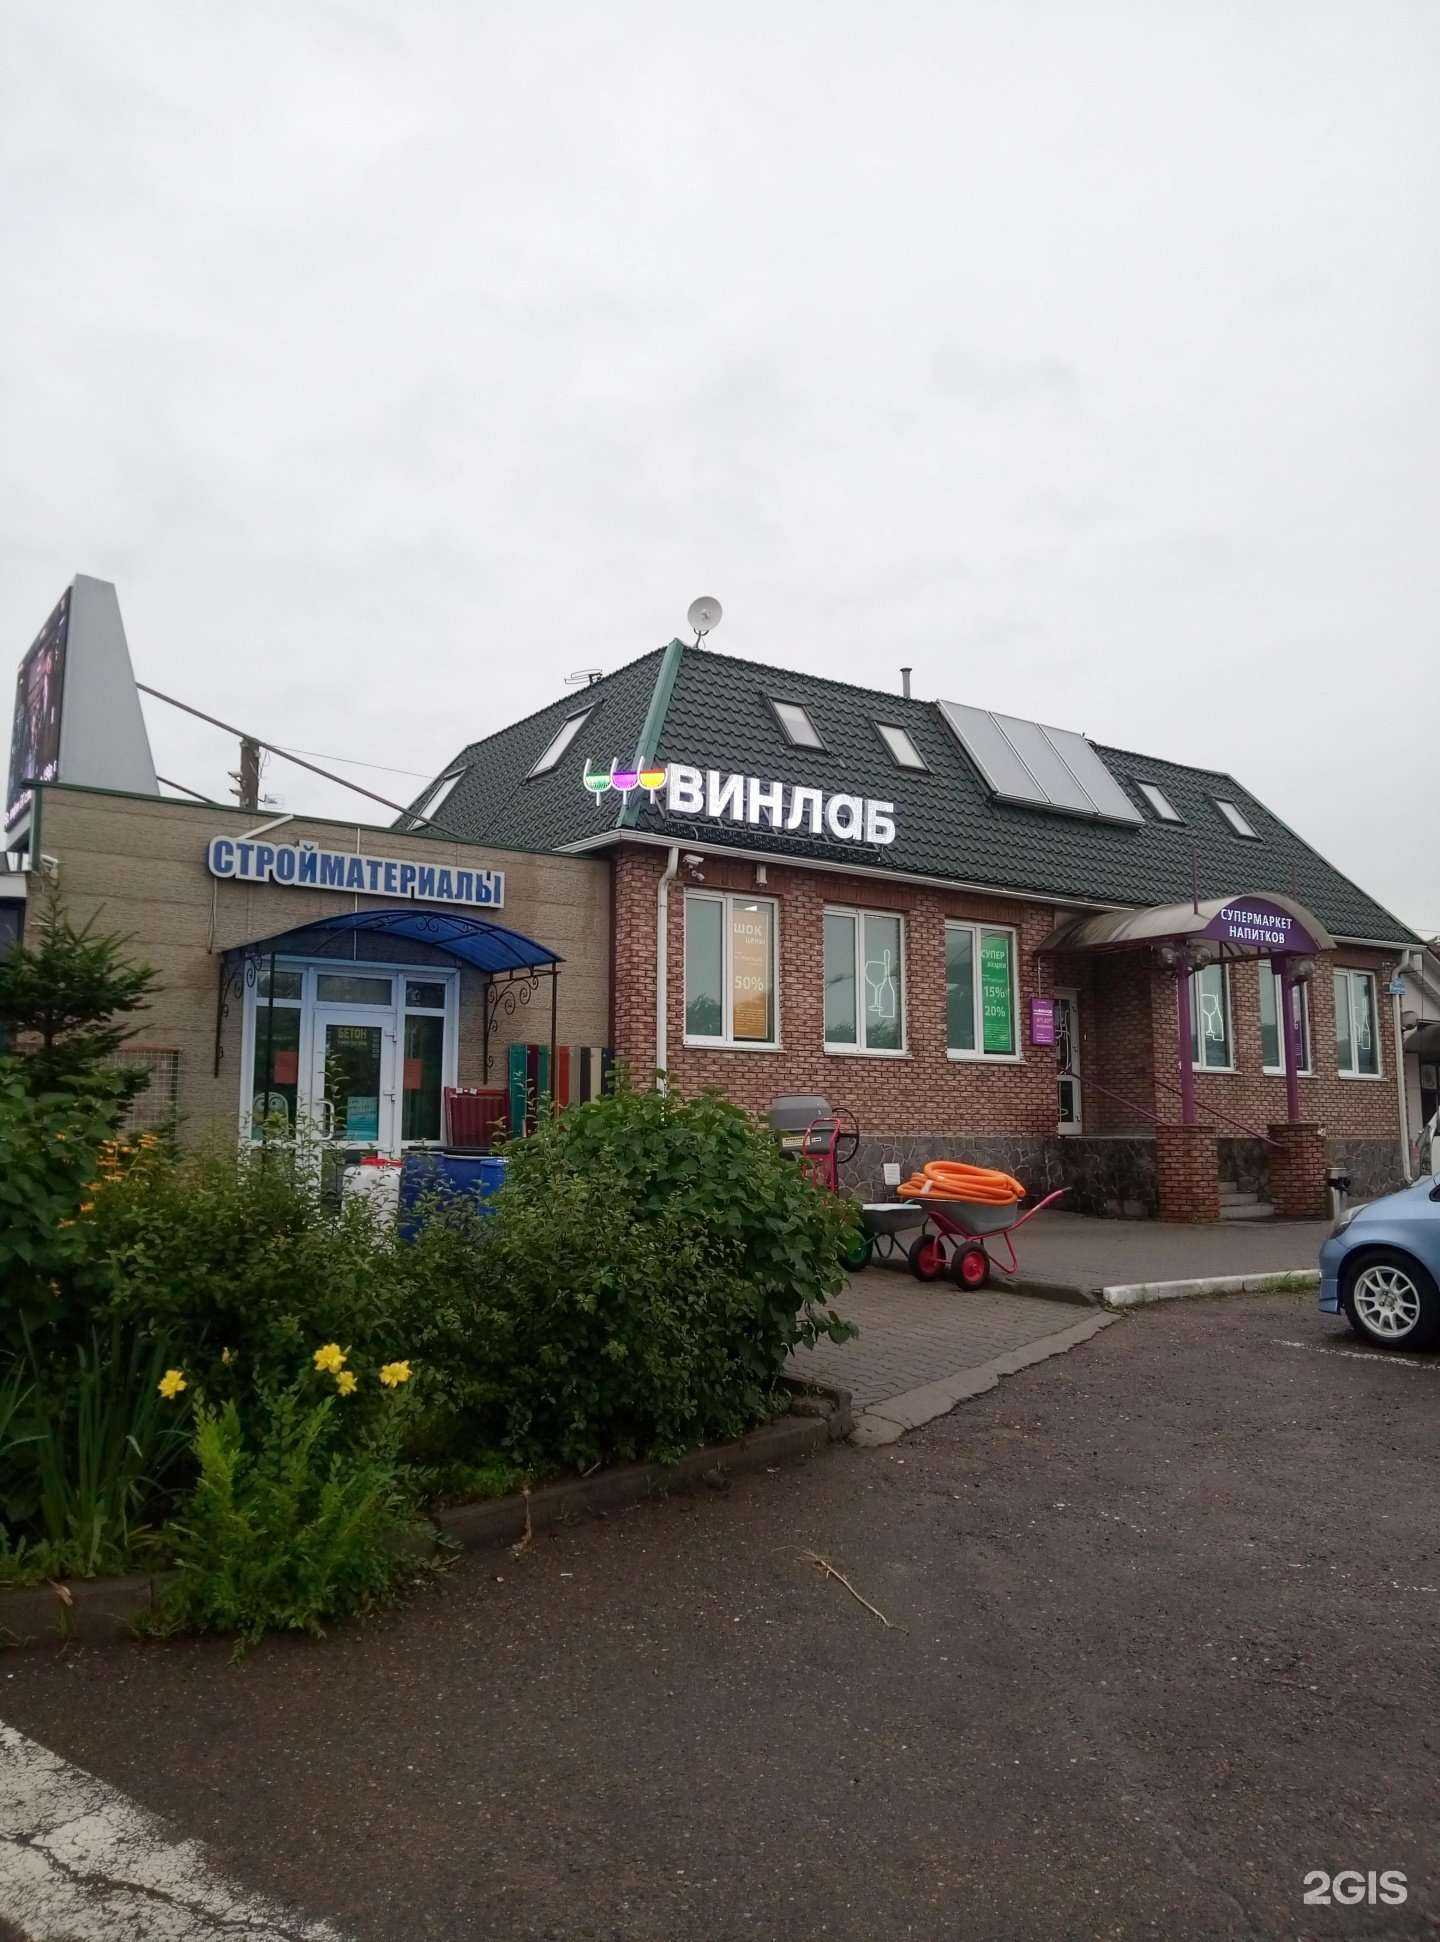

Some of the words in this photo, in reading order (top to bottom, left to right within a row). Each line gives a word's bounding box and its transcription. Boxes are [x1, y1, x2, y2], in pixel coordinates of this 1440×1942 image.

[213, 840, 501, 904] СТРОЙМАТЕРИАЛЫ
[1220, 909, 1292, 929] СУПЕРМАРКЕТ
[1229, 926, 1285, 943] НАПИТКОВ
[734, 976, 764, 992] 50%
